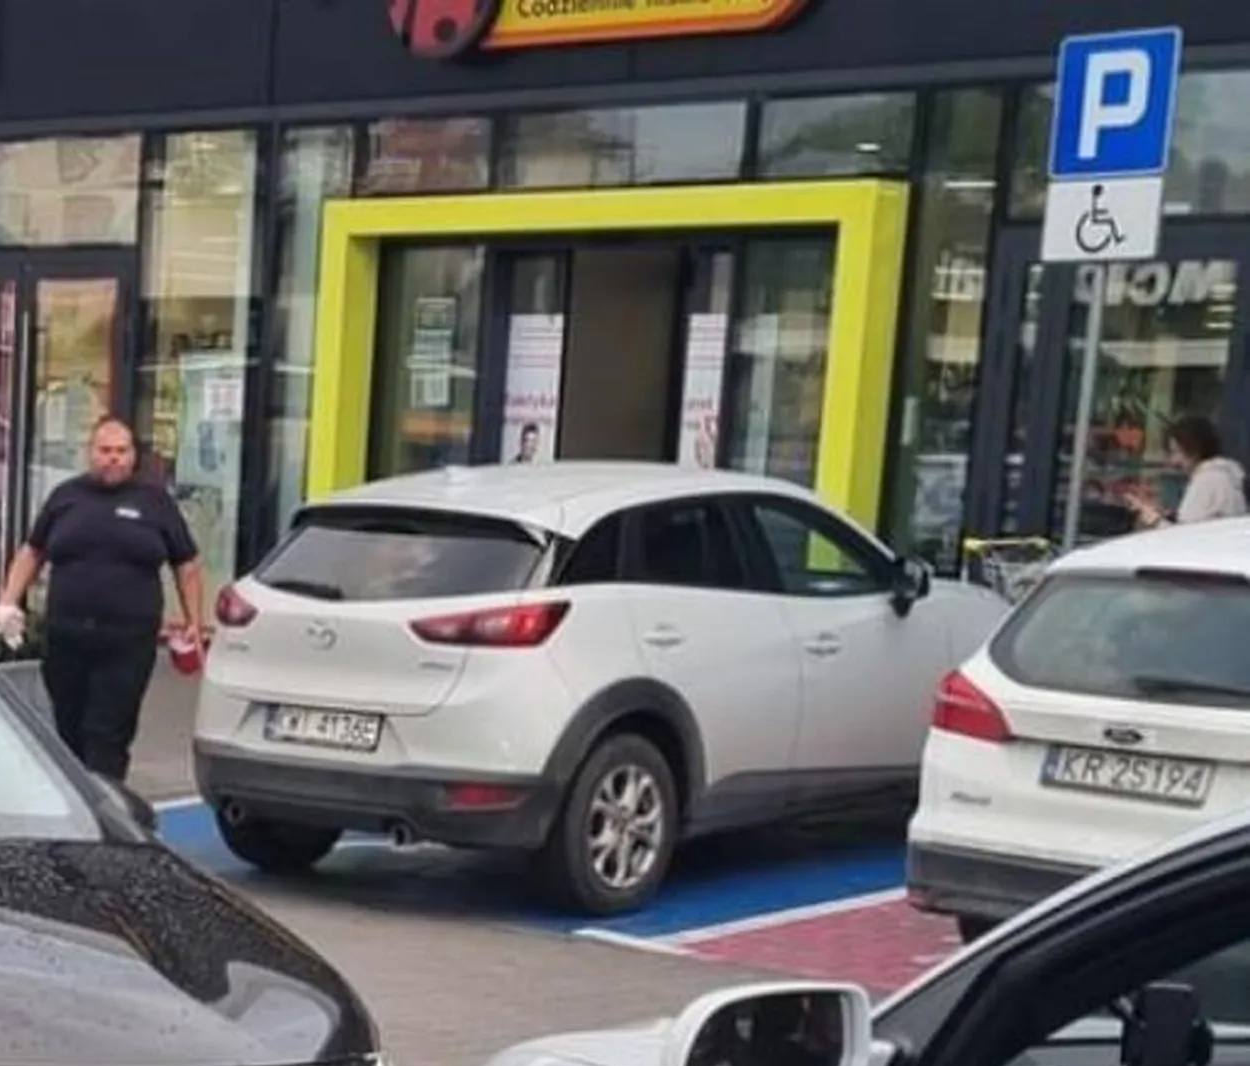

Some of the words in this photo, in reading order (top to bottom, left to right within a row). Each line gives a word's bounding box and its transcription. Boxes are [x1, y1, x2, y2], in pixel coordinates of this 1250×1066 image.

[1077, 49, 1151, 160] P
[1060, 751, 1104, 782] KR
[1110, 756, 1204, 796] 25194
